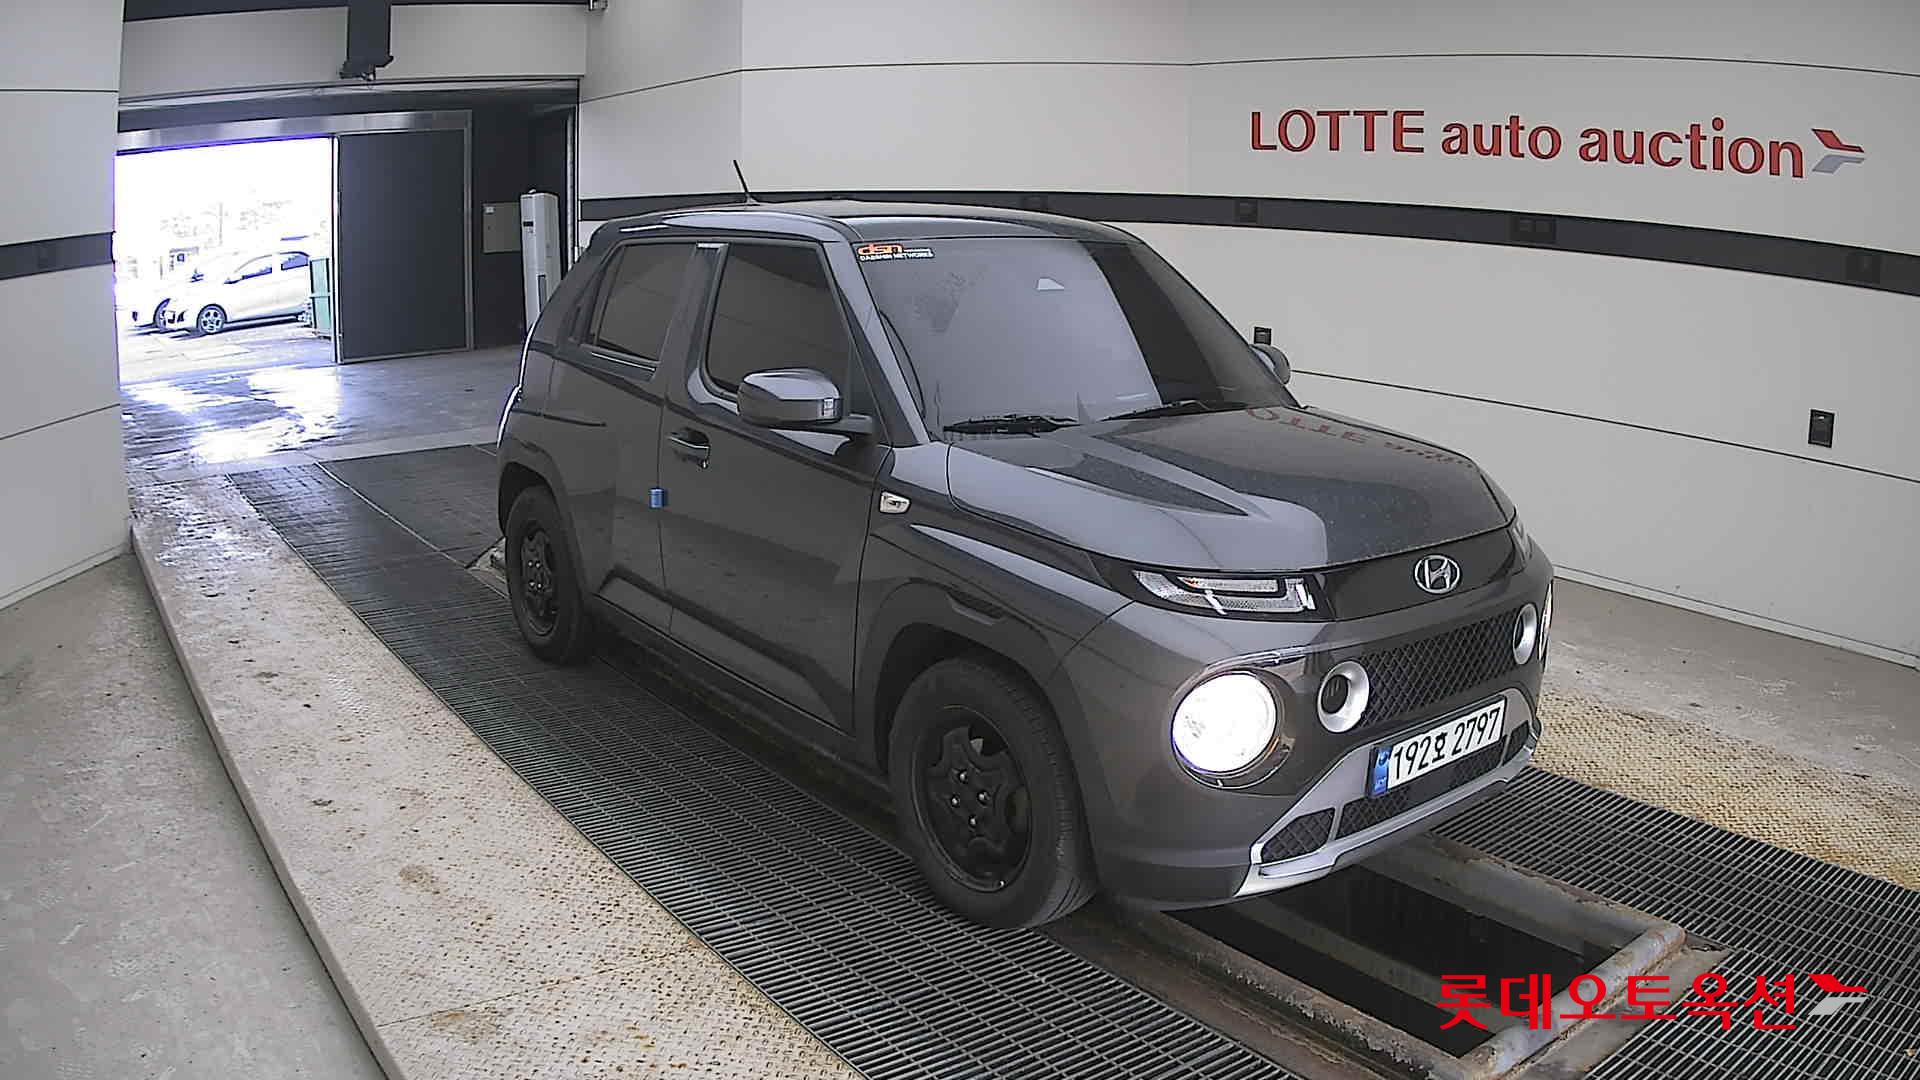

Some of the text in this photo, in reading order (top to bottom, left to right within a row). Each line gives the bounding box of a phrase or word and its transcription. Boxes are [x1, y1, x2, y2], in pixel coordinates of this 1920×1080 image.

[1250, 110, 1805, 178] LOTTE auto auction
[1394, 707, 1501, 780] 192호 2797
